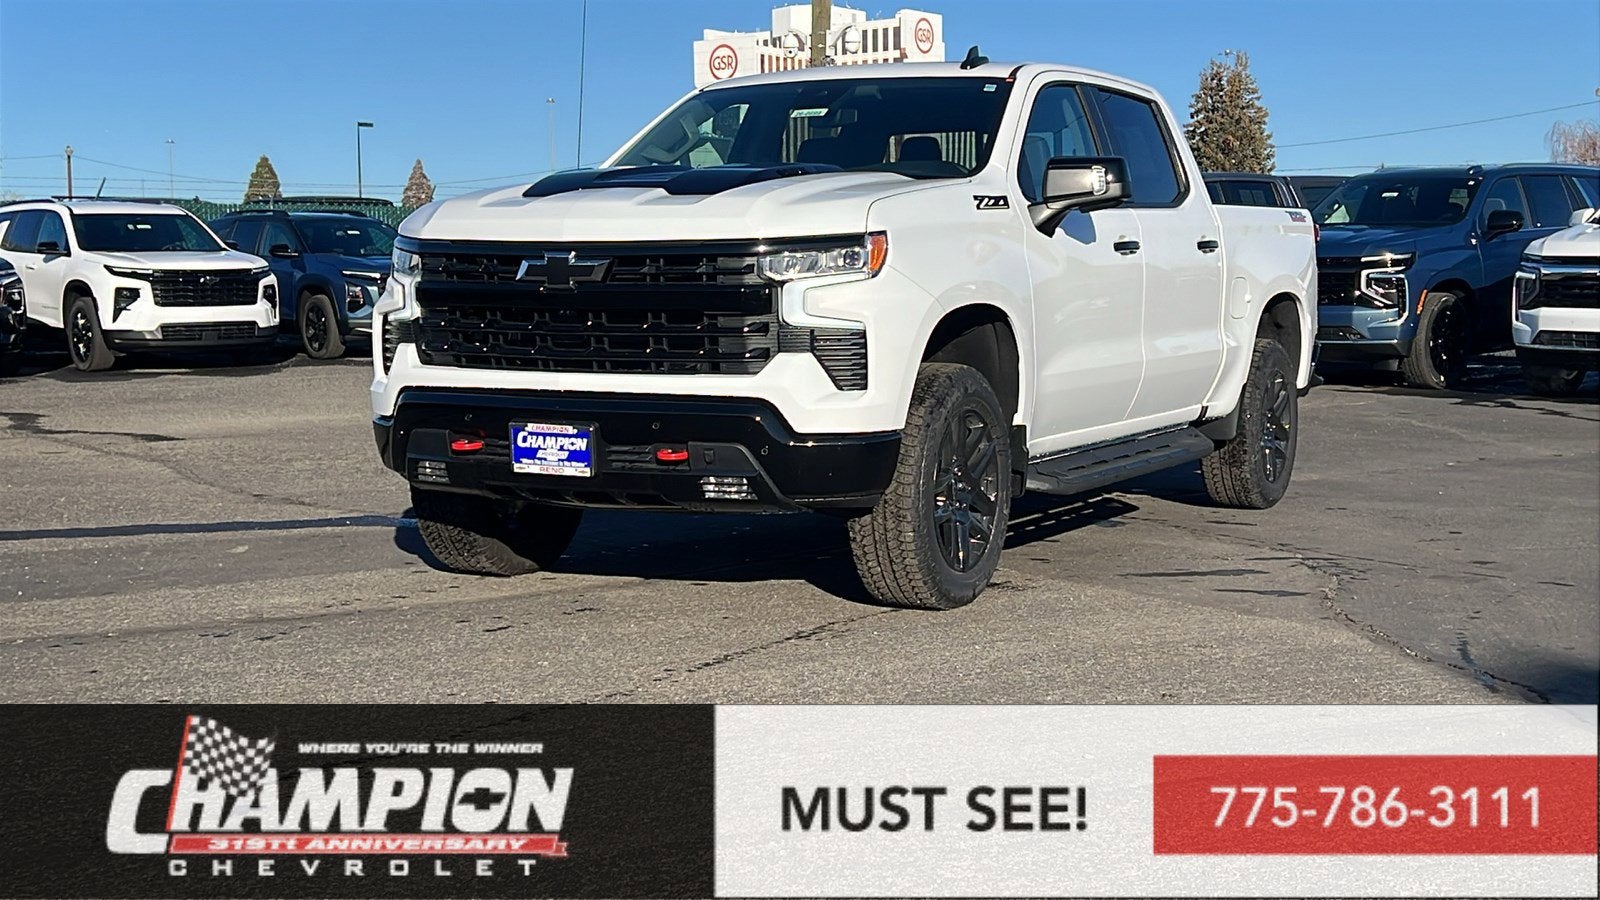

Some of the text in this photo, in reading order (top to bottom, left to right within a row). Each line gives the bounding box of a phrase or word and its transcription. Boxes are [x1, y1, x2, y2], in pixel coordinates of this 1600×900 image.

[917, 27, 932, 44] GSR
[712, 54, 734, 71] GSR
[531, 425, 570, 433] CHAMPION
[516, 431, 588, 451] CHAMPION
[539, 466, 565, 474] RENO
